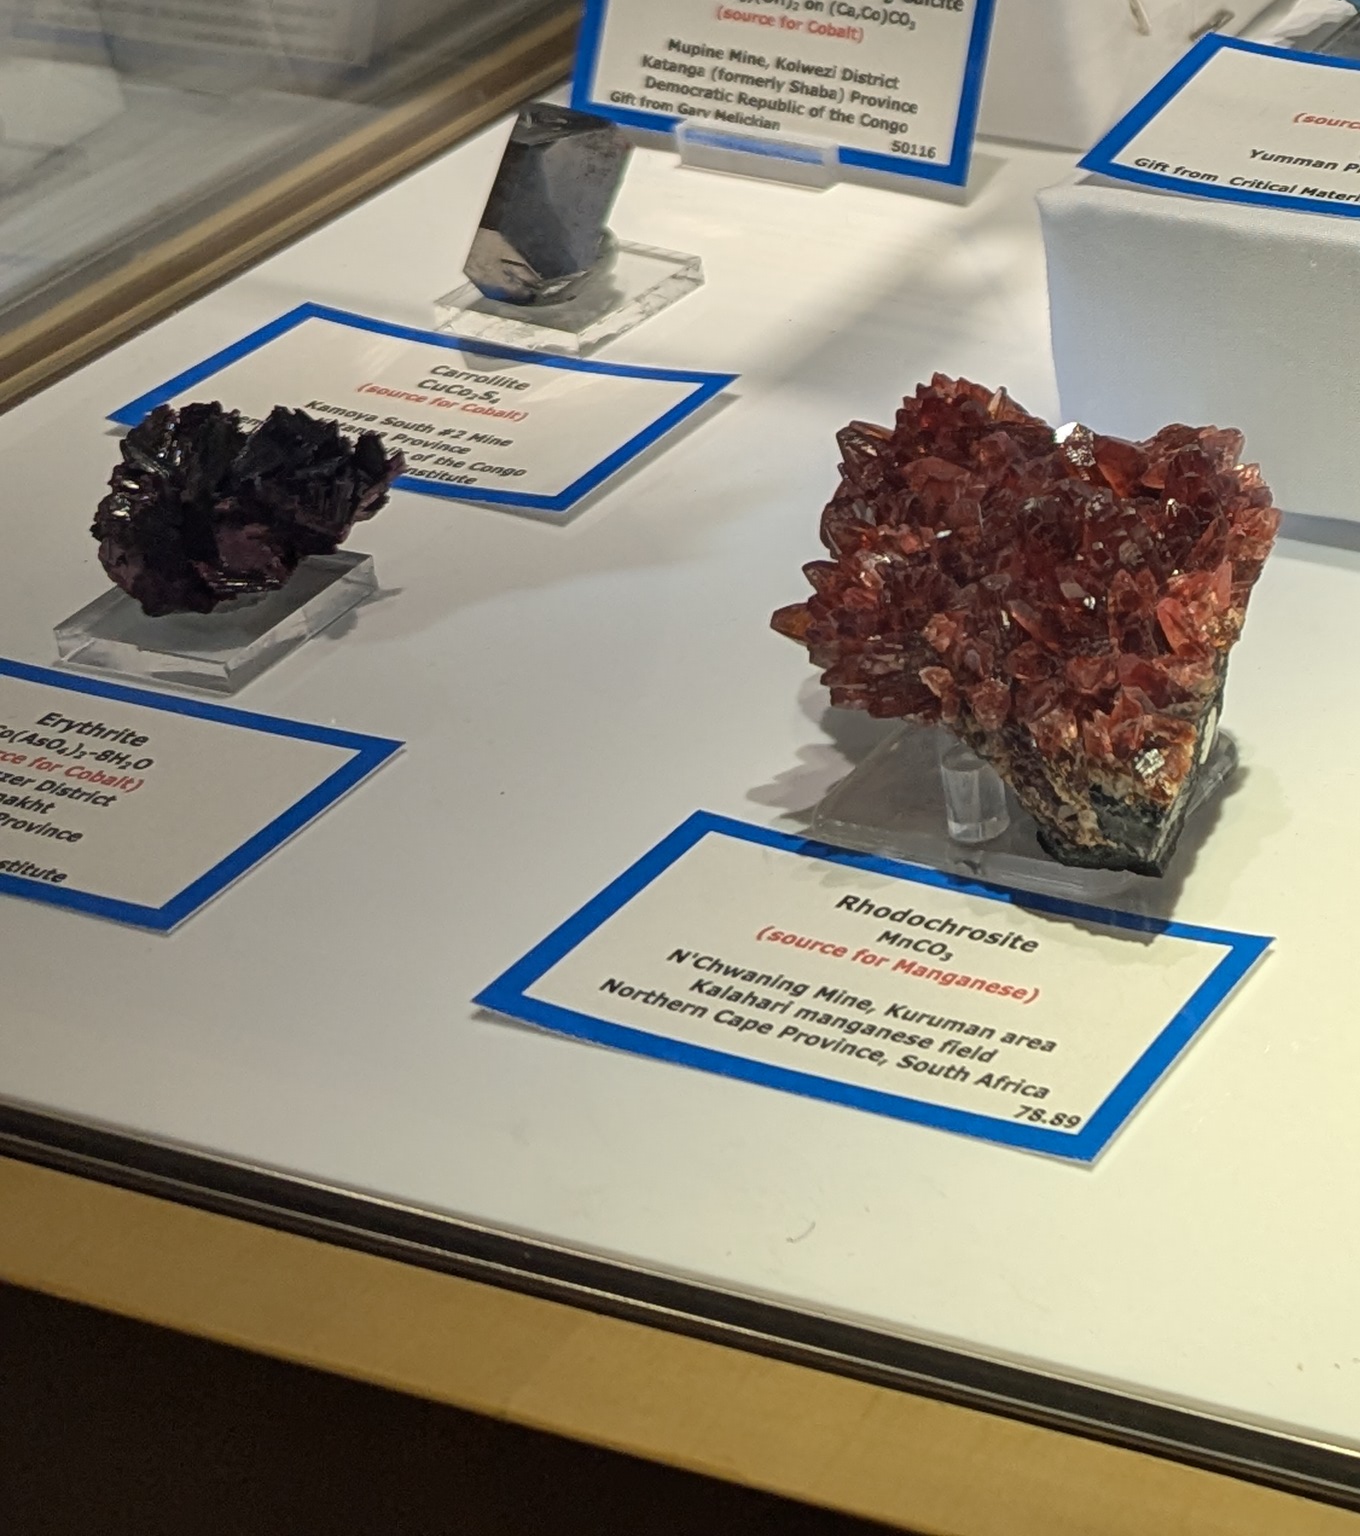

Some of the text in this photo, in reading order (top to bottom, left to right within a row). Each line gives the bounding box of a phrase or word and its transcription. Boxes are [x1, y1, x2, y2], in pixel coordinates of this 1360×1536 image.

[715, 4, 864, 44] (source for Cobalt)
[802, 0, 824, 12] on
[666, 38, 900, 90] Mupine Mine, Kolwezi District
[641, 54, 918, 115] Katanga (formerly Shaba) Province
[1133, 157, 1170, 173] Gift
[1169, 165, 1219, 182] from
[1228, 176, 1298, 194] Critical
[429, 364, 530, 391] Carrollite
[356, 382, 529, 422] (source for Cobalt)
[306, 400, 514, 447] Kamoya South #2 Mine
[389, 432, 472, 455] Province
[35, 711, 149, 747] Erythrite
[26, 756, 64, 773] for
[63, 765, 144, 793] Cobalt)
[33, 779, 117, 807] District
[835, 894, 1038, 953] Rhodochrosite
[755, 925, 1039, 1004] (source for Manganese)
[599, 978, 708, 1018] Northern
[666, 948, 1057, 1053] N'Chwaning Mine, Kuruman area
[688, 978, 999, 1063] Kalahari manganese field
